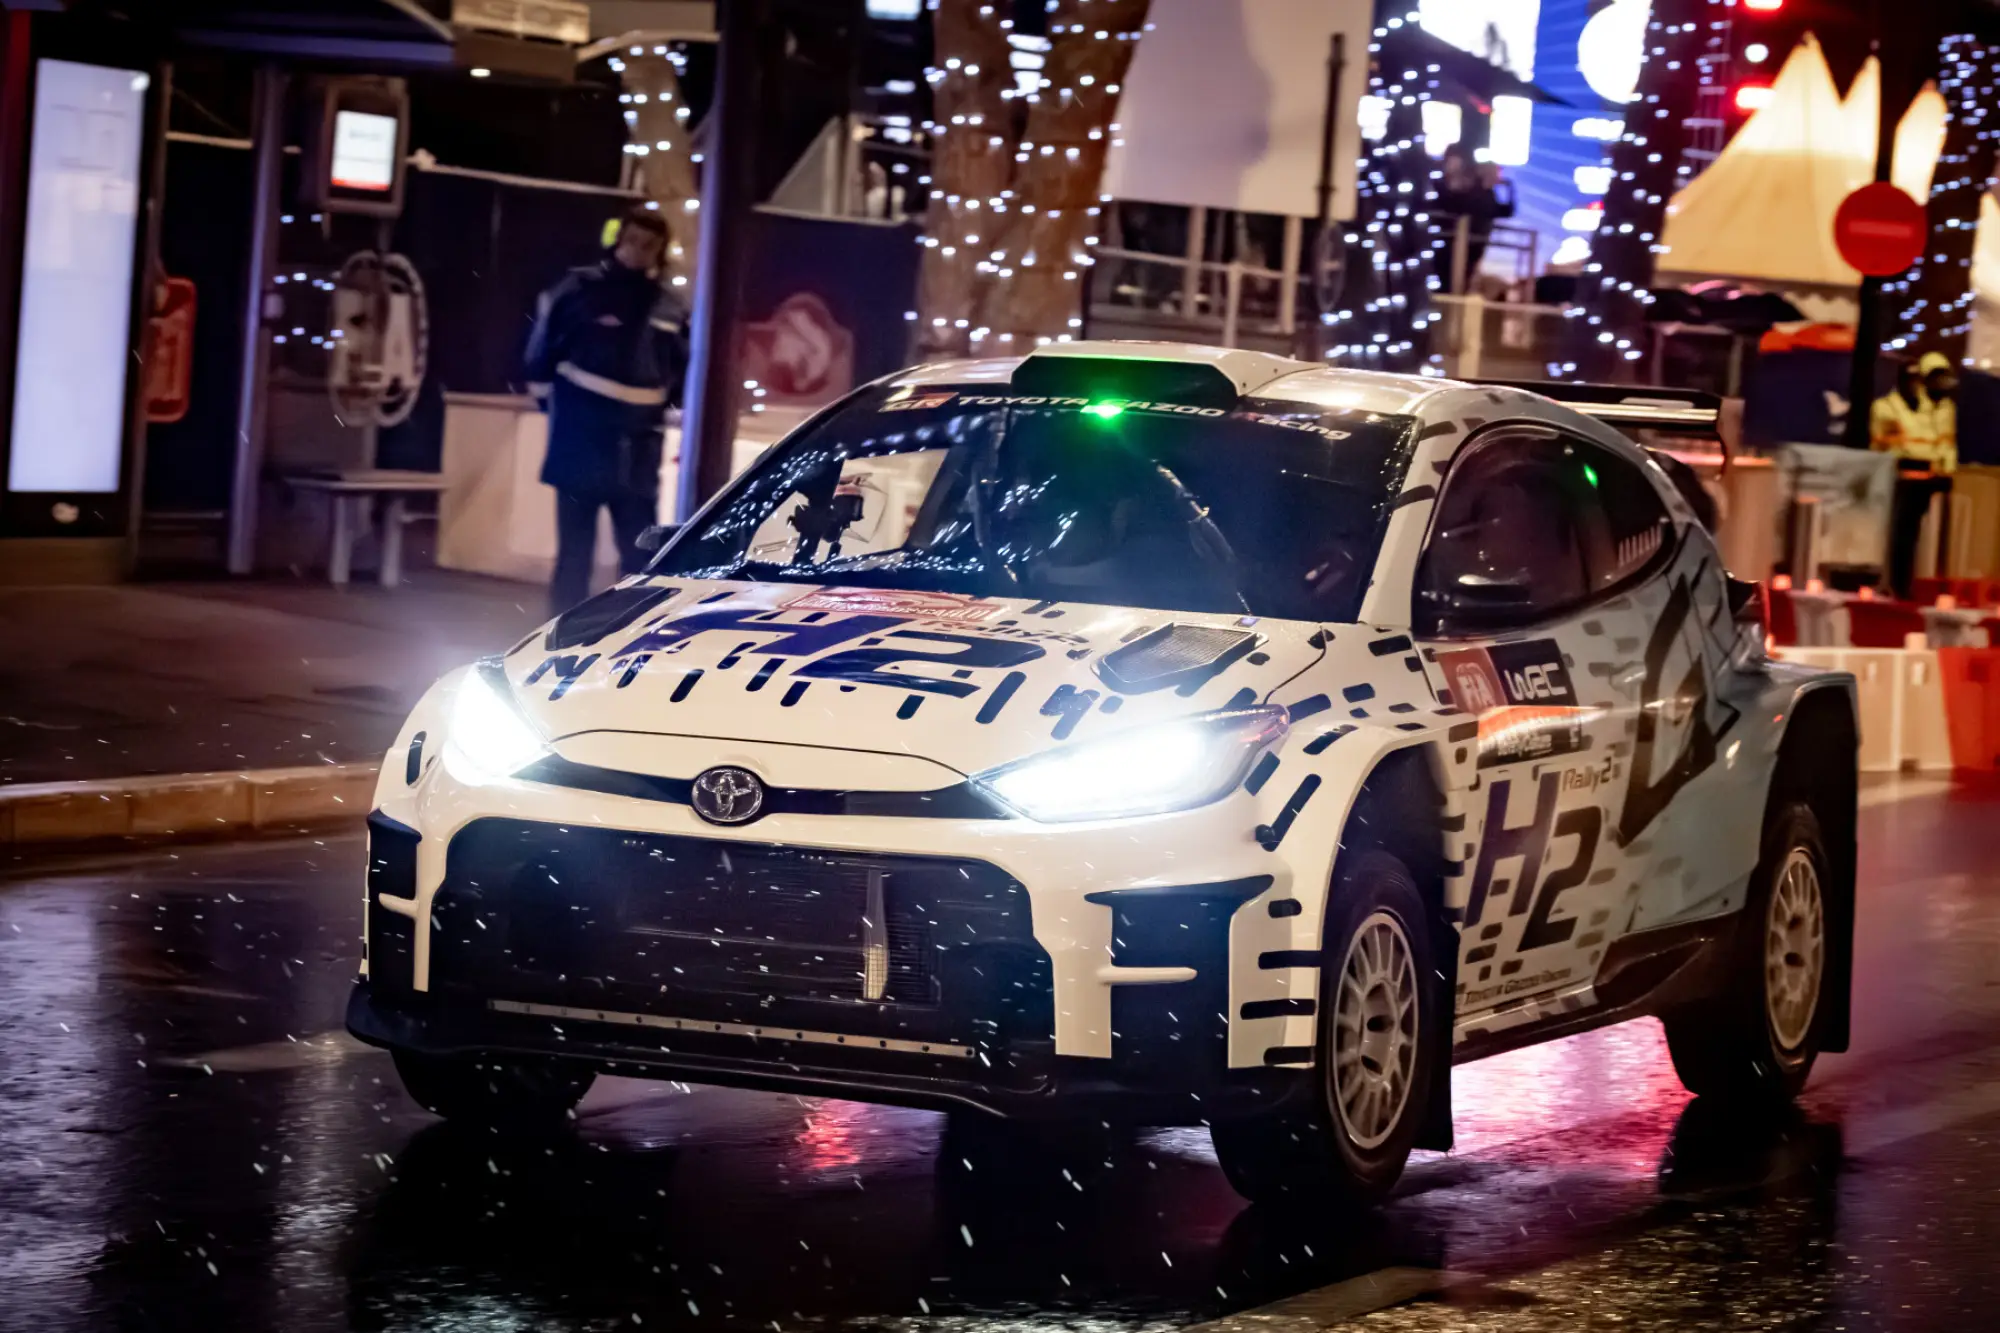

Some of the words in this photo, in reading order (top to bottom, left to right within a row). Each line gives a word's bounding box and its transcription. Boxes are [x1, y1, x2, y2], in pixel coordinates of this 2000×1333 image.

[958, 396, 1090, 406] TOYOTA
[1504, 662, 1567, 701] WRC
[1562, 756, 1613, 793] Rally2
[1462, 770, 1602, 953] H2
